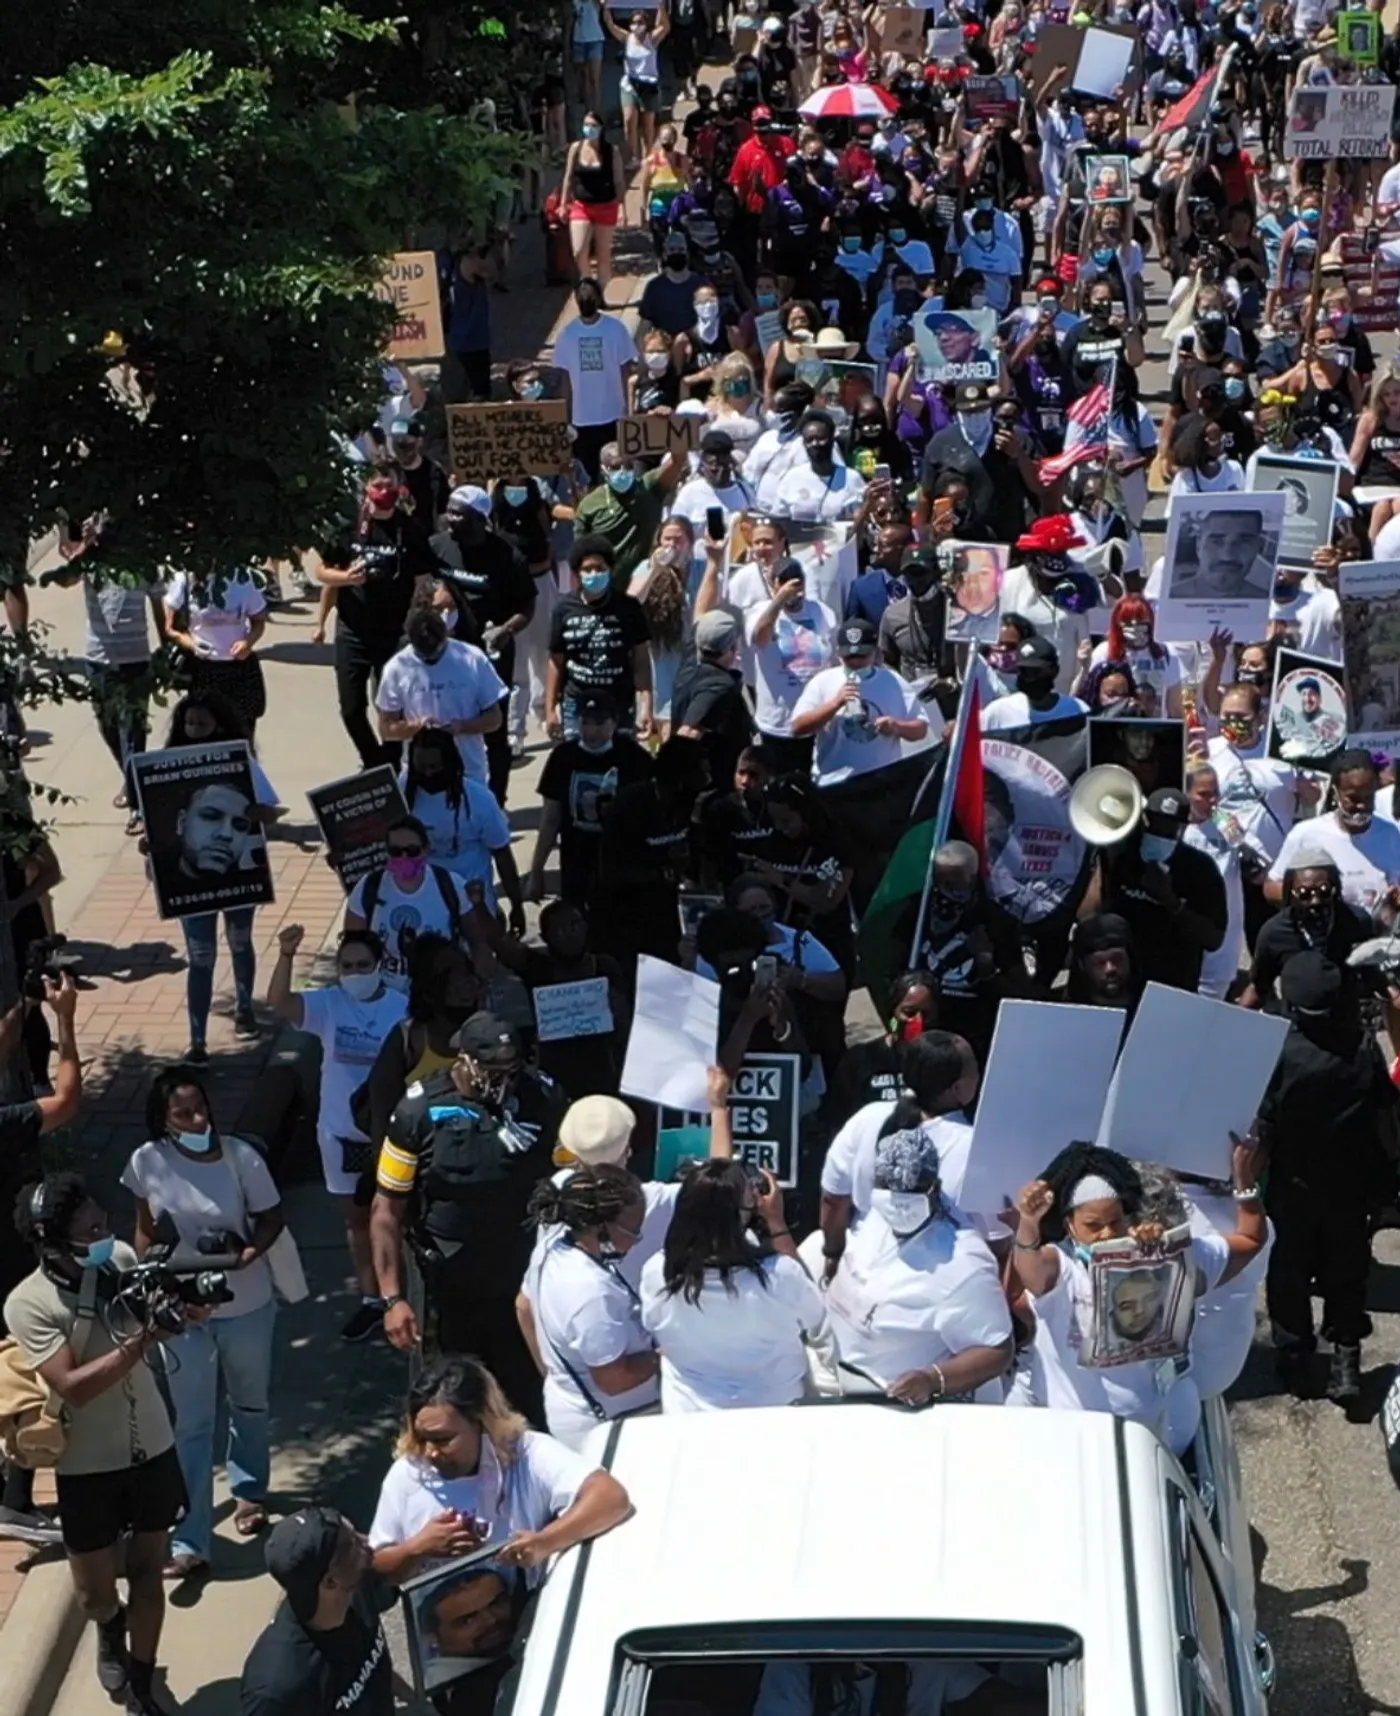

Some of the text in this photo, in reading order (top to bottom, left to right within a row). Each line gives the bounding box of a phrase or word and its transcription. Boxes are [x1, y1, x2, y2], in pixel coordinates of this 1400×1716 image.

[1293, 140, 1334, 156] TOTAL
[624, 417, 692, 455] BLM
[456, 451, 561, 470] OUT FOR HIS
[153, 750, 231, 770] JUSTICE FOR
[144, 771, 180, 786] BRIAN
